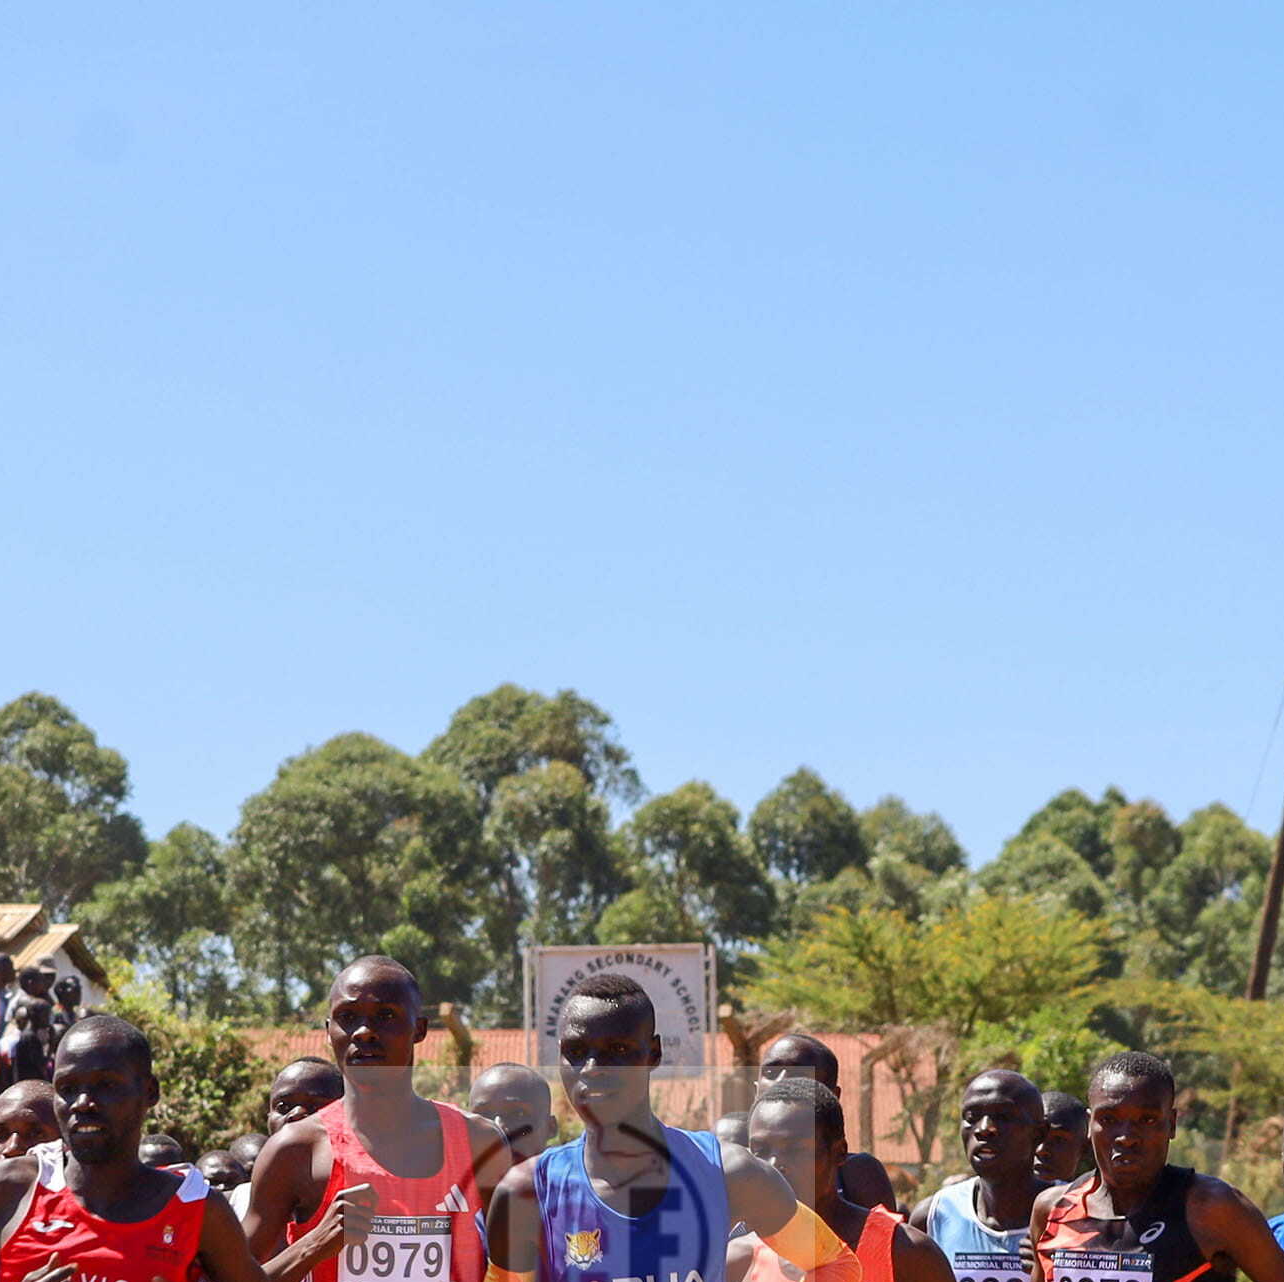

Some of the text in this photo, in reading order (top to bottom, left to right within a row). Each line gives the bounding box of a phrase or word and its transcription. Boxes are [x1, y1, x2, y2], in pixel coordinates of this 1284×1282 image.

[587, 953, 671, 976] SECONDARY
[670, 976, 701, 1033] SCHOOL
[395, 1224, 417, 1235] RUN
[345, 1241, 444, 1279] 0979
[954, 1261, 1001, 1270] MEMORIAL
[1099, 1260, 1117, 1270] RUN
